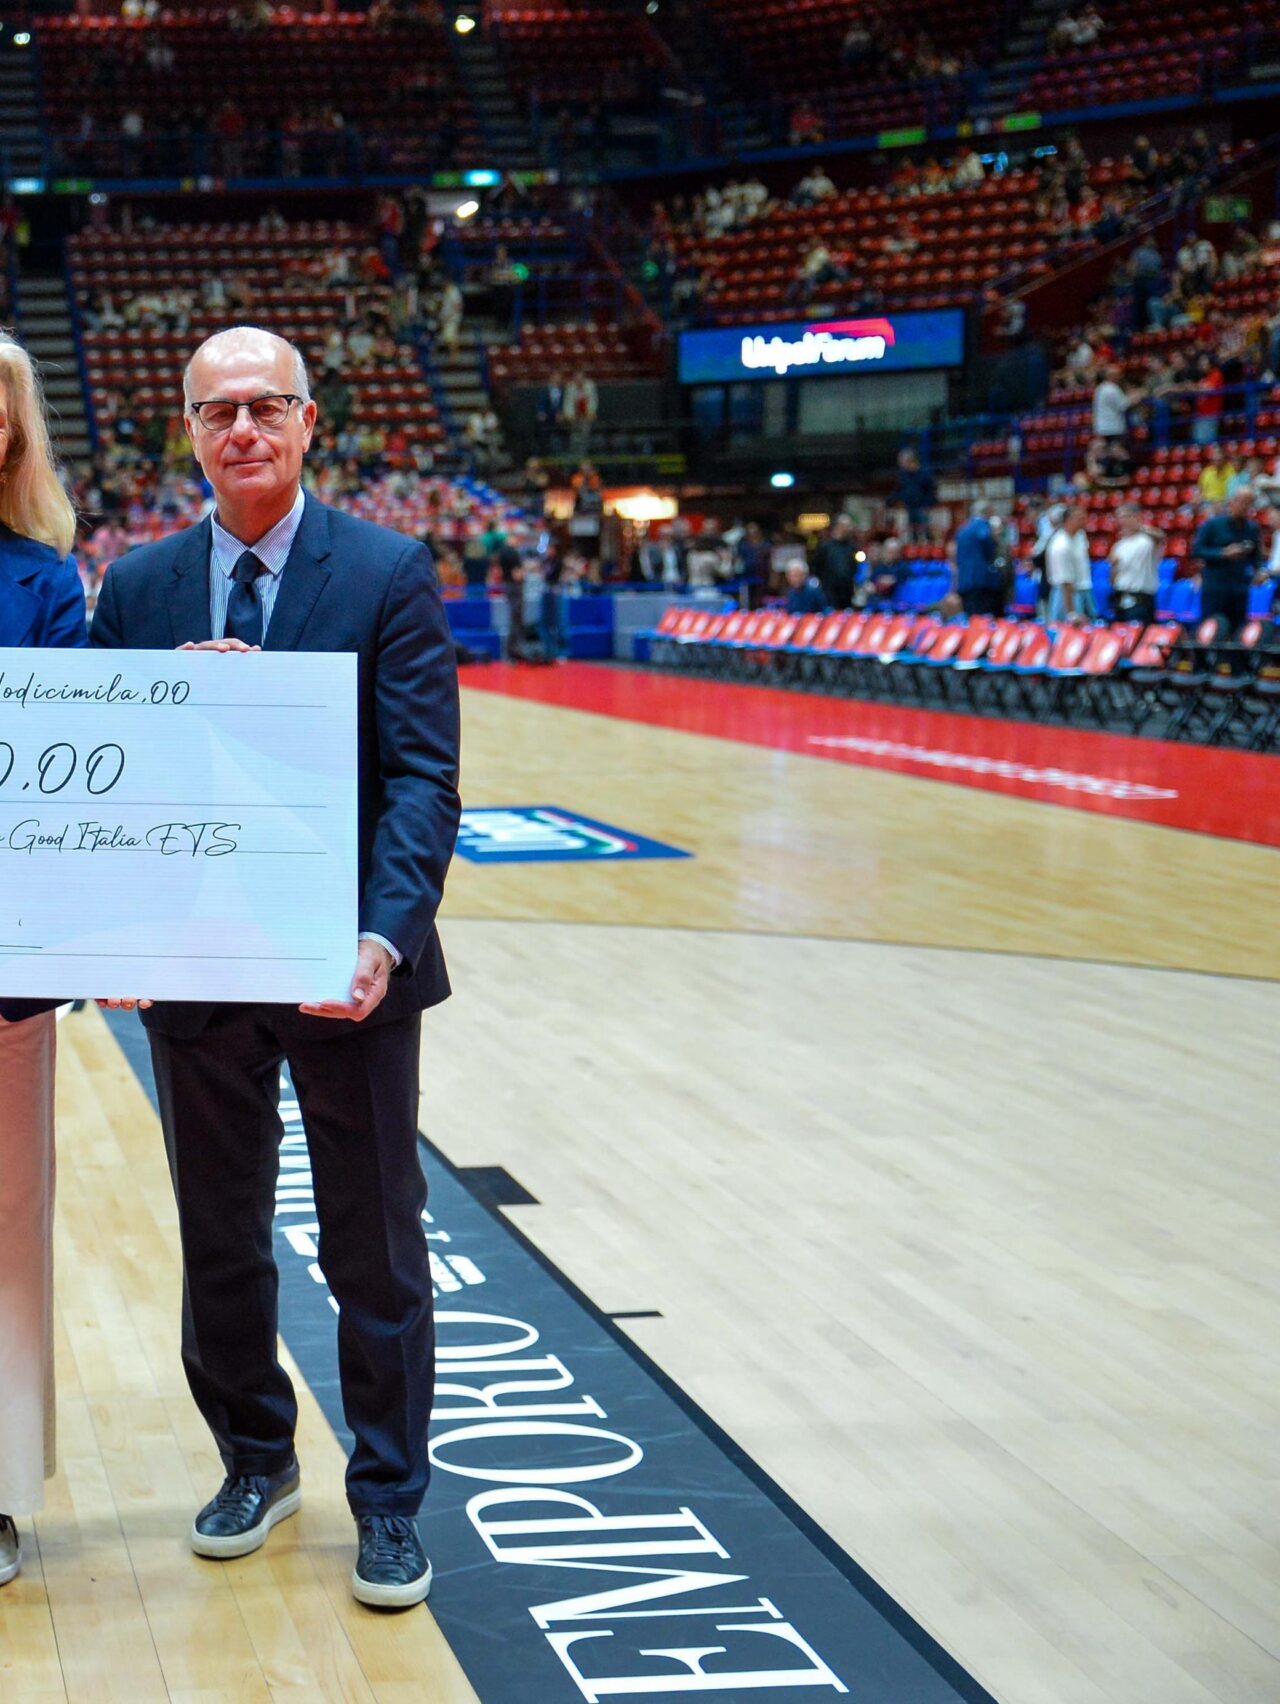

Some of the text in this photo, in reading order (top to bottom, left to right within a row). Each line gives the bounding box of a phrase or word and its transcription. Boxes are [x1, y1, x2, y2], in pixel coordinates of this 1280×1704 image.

[8, 819, 70, 855] Good
[72, 821, 142, 853] Italia
[145, 822, 242, 857] ETS
